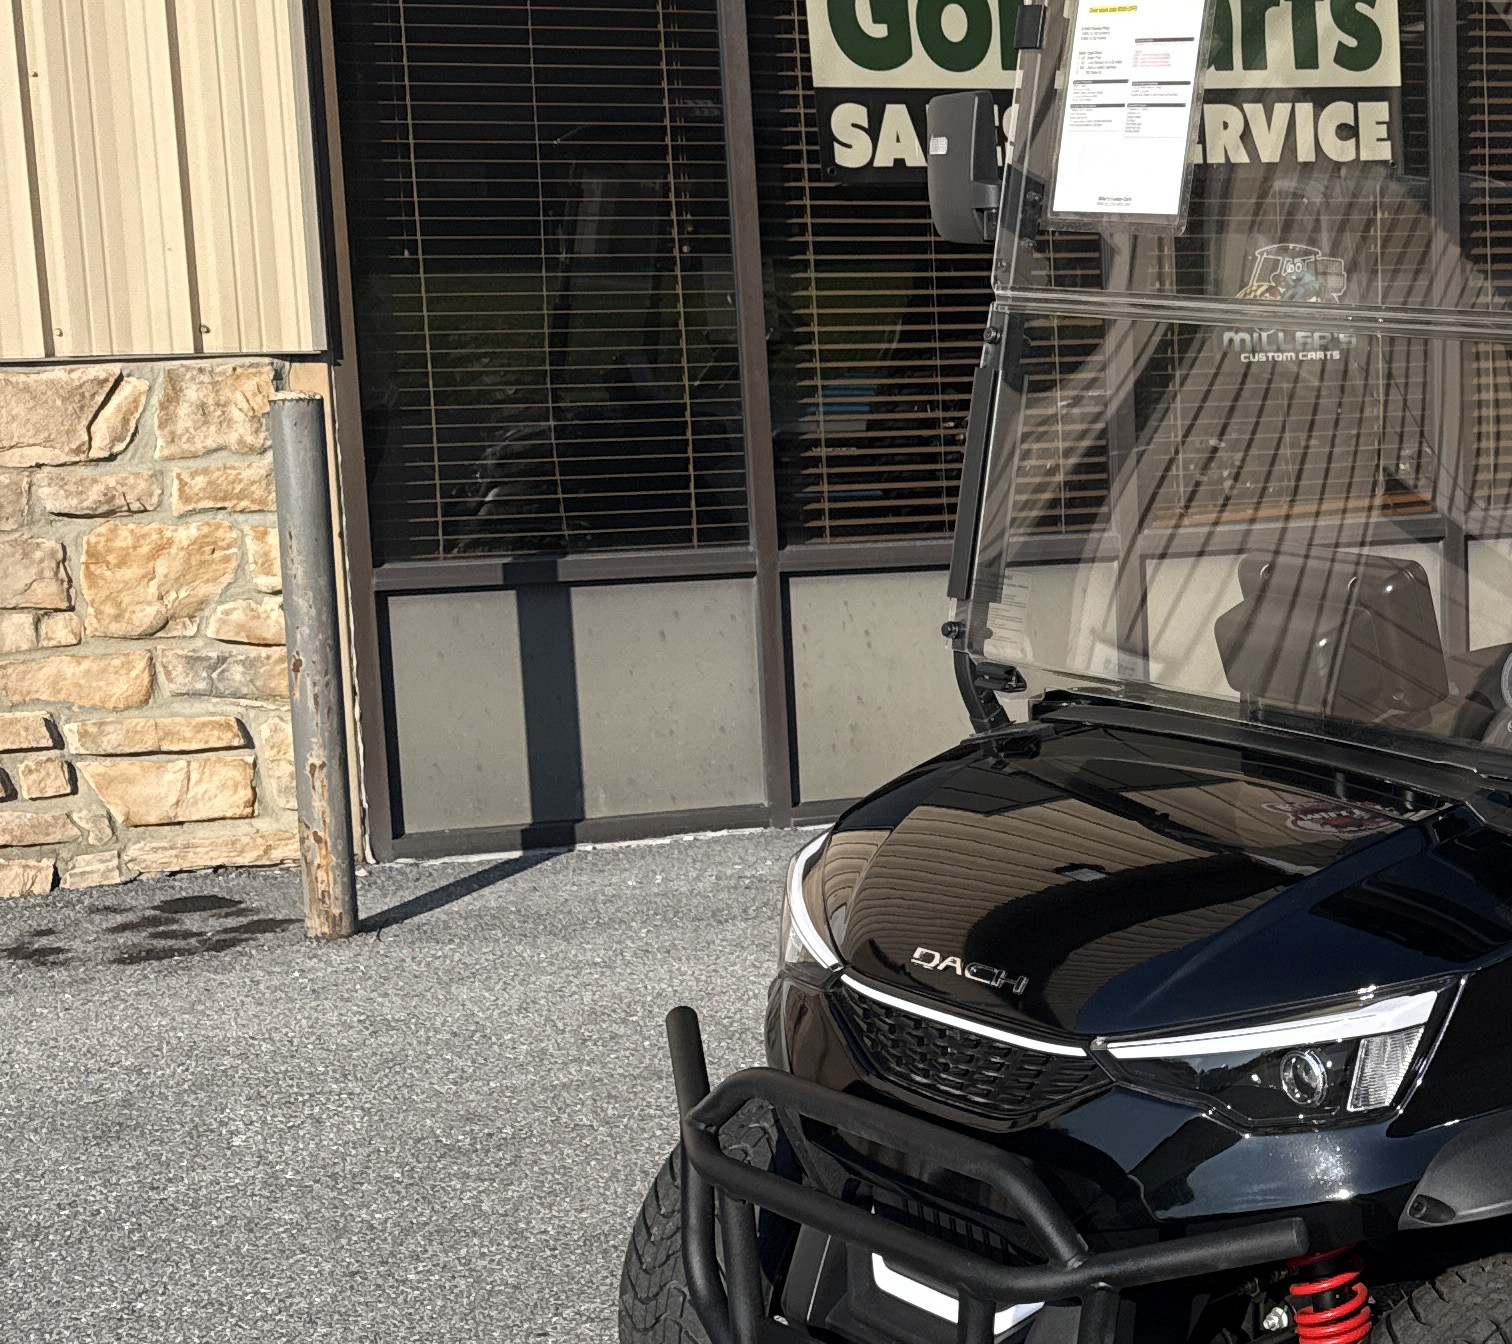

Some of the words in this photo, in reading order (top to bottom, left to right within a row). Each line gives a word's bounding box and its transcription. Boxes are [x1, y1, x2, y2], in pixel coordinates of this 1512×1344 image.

[1190, 101, 1392, 164] RVICE
[1223, 331, 1357, 352] MILLER'S
[1240, 352, 1295, 362] CUSTOM
[1298, 350, 1340, 360] CARTS
[911, 946, 1029, 995] DACH
